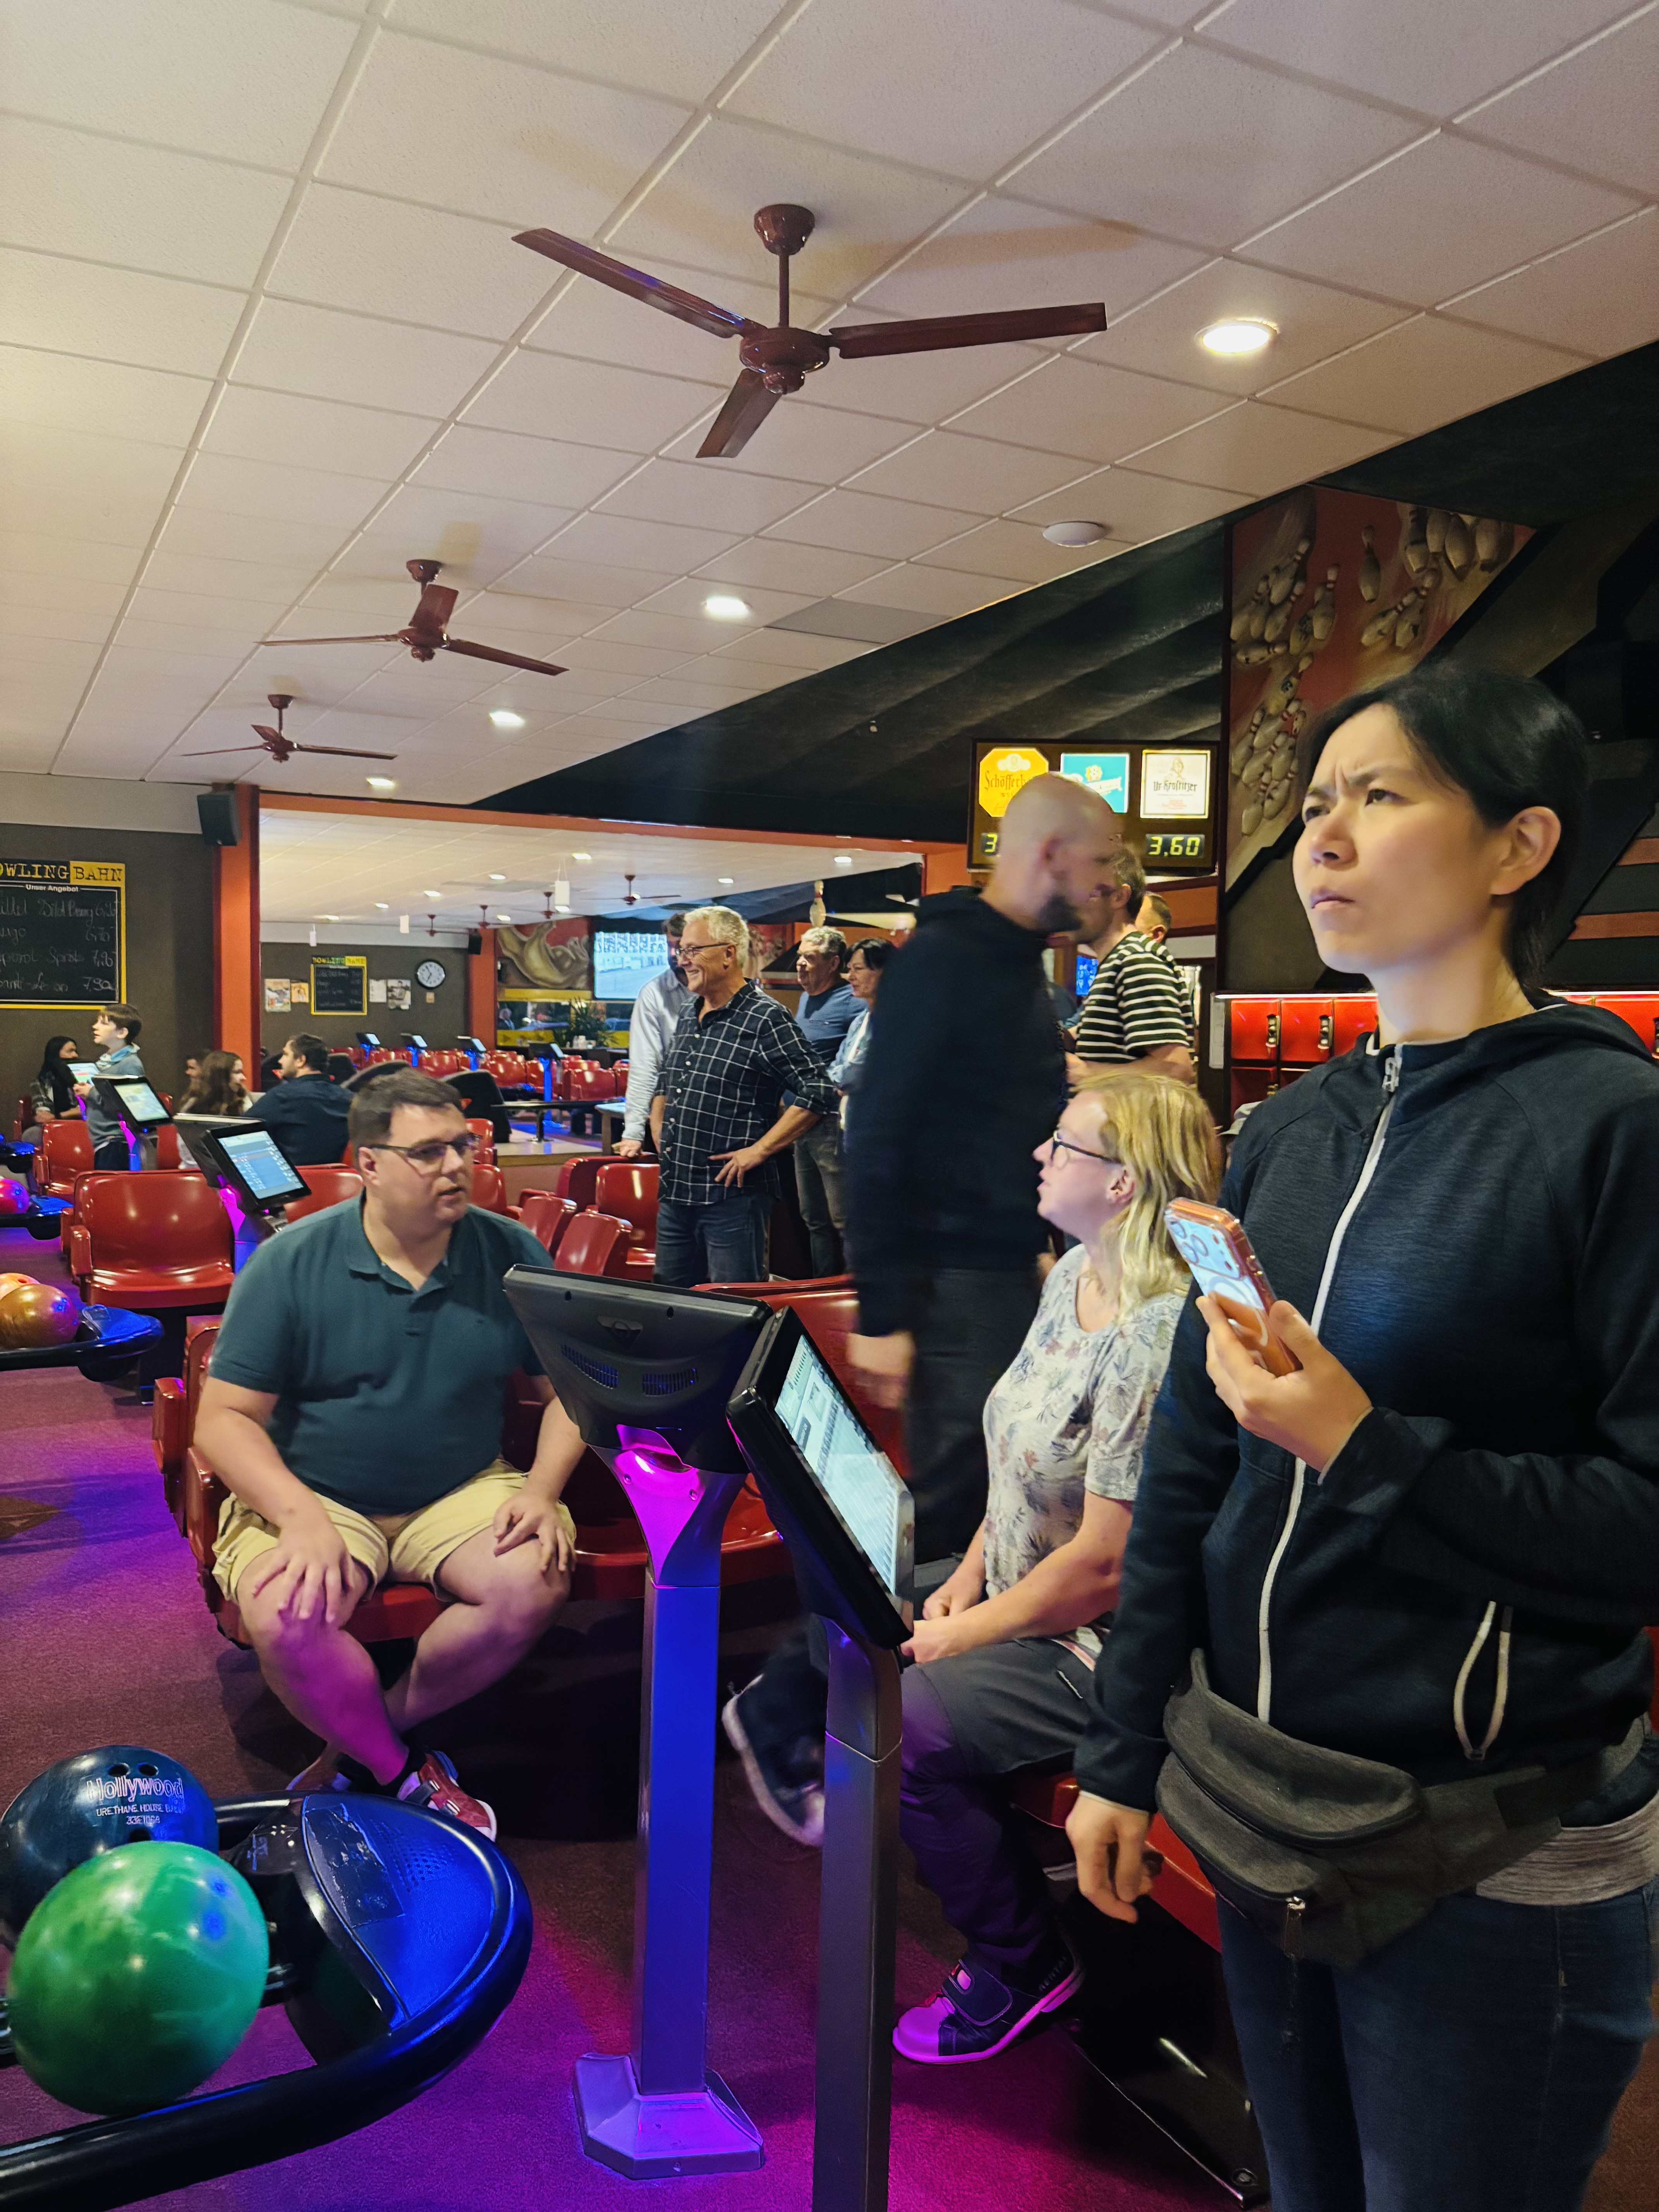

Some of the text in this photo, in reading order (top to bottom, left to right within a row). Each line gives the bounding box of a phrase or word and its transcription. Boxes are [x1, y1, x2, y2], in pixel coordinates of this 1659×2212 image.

[984, 770, 1026, 791] Schöfferh
[985, 834, 997, 852] 3
[0, 863, 122, 881] WLING BAHN
[86, 1775, 184, 1802] Hollywood
[96, 1804, 137, 1817] URETHANE
[140, 1803, 163, 1813] HOUSE
